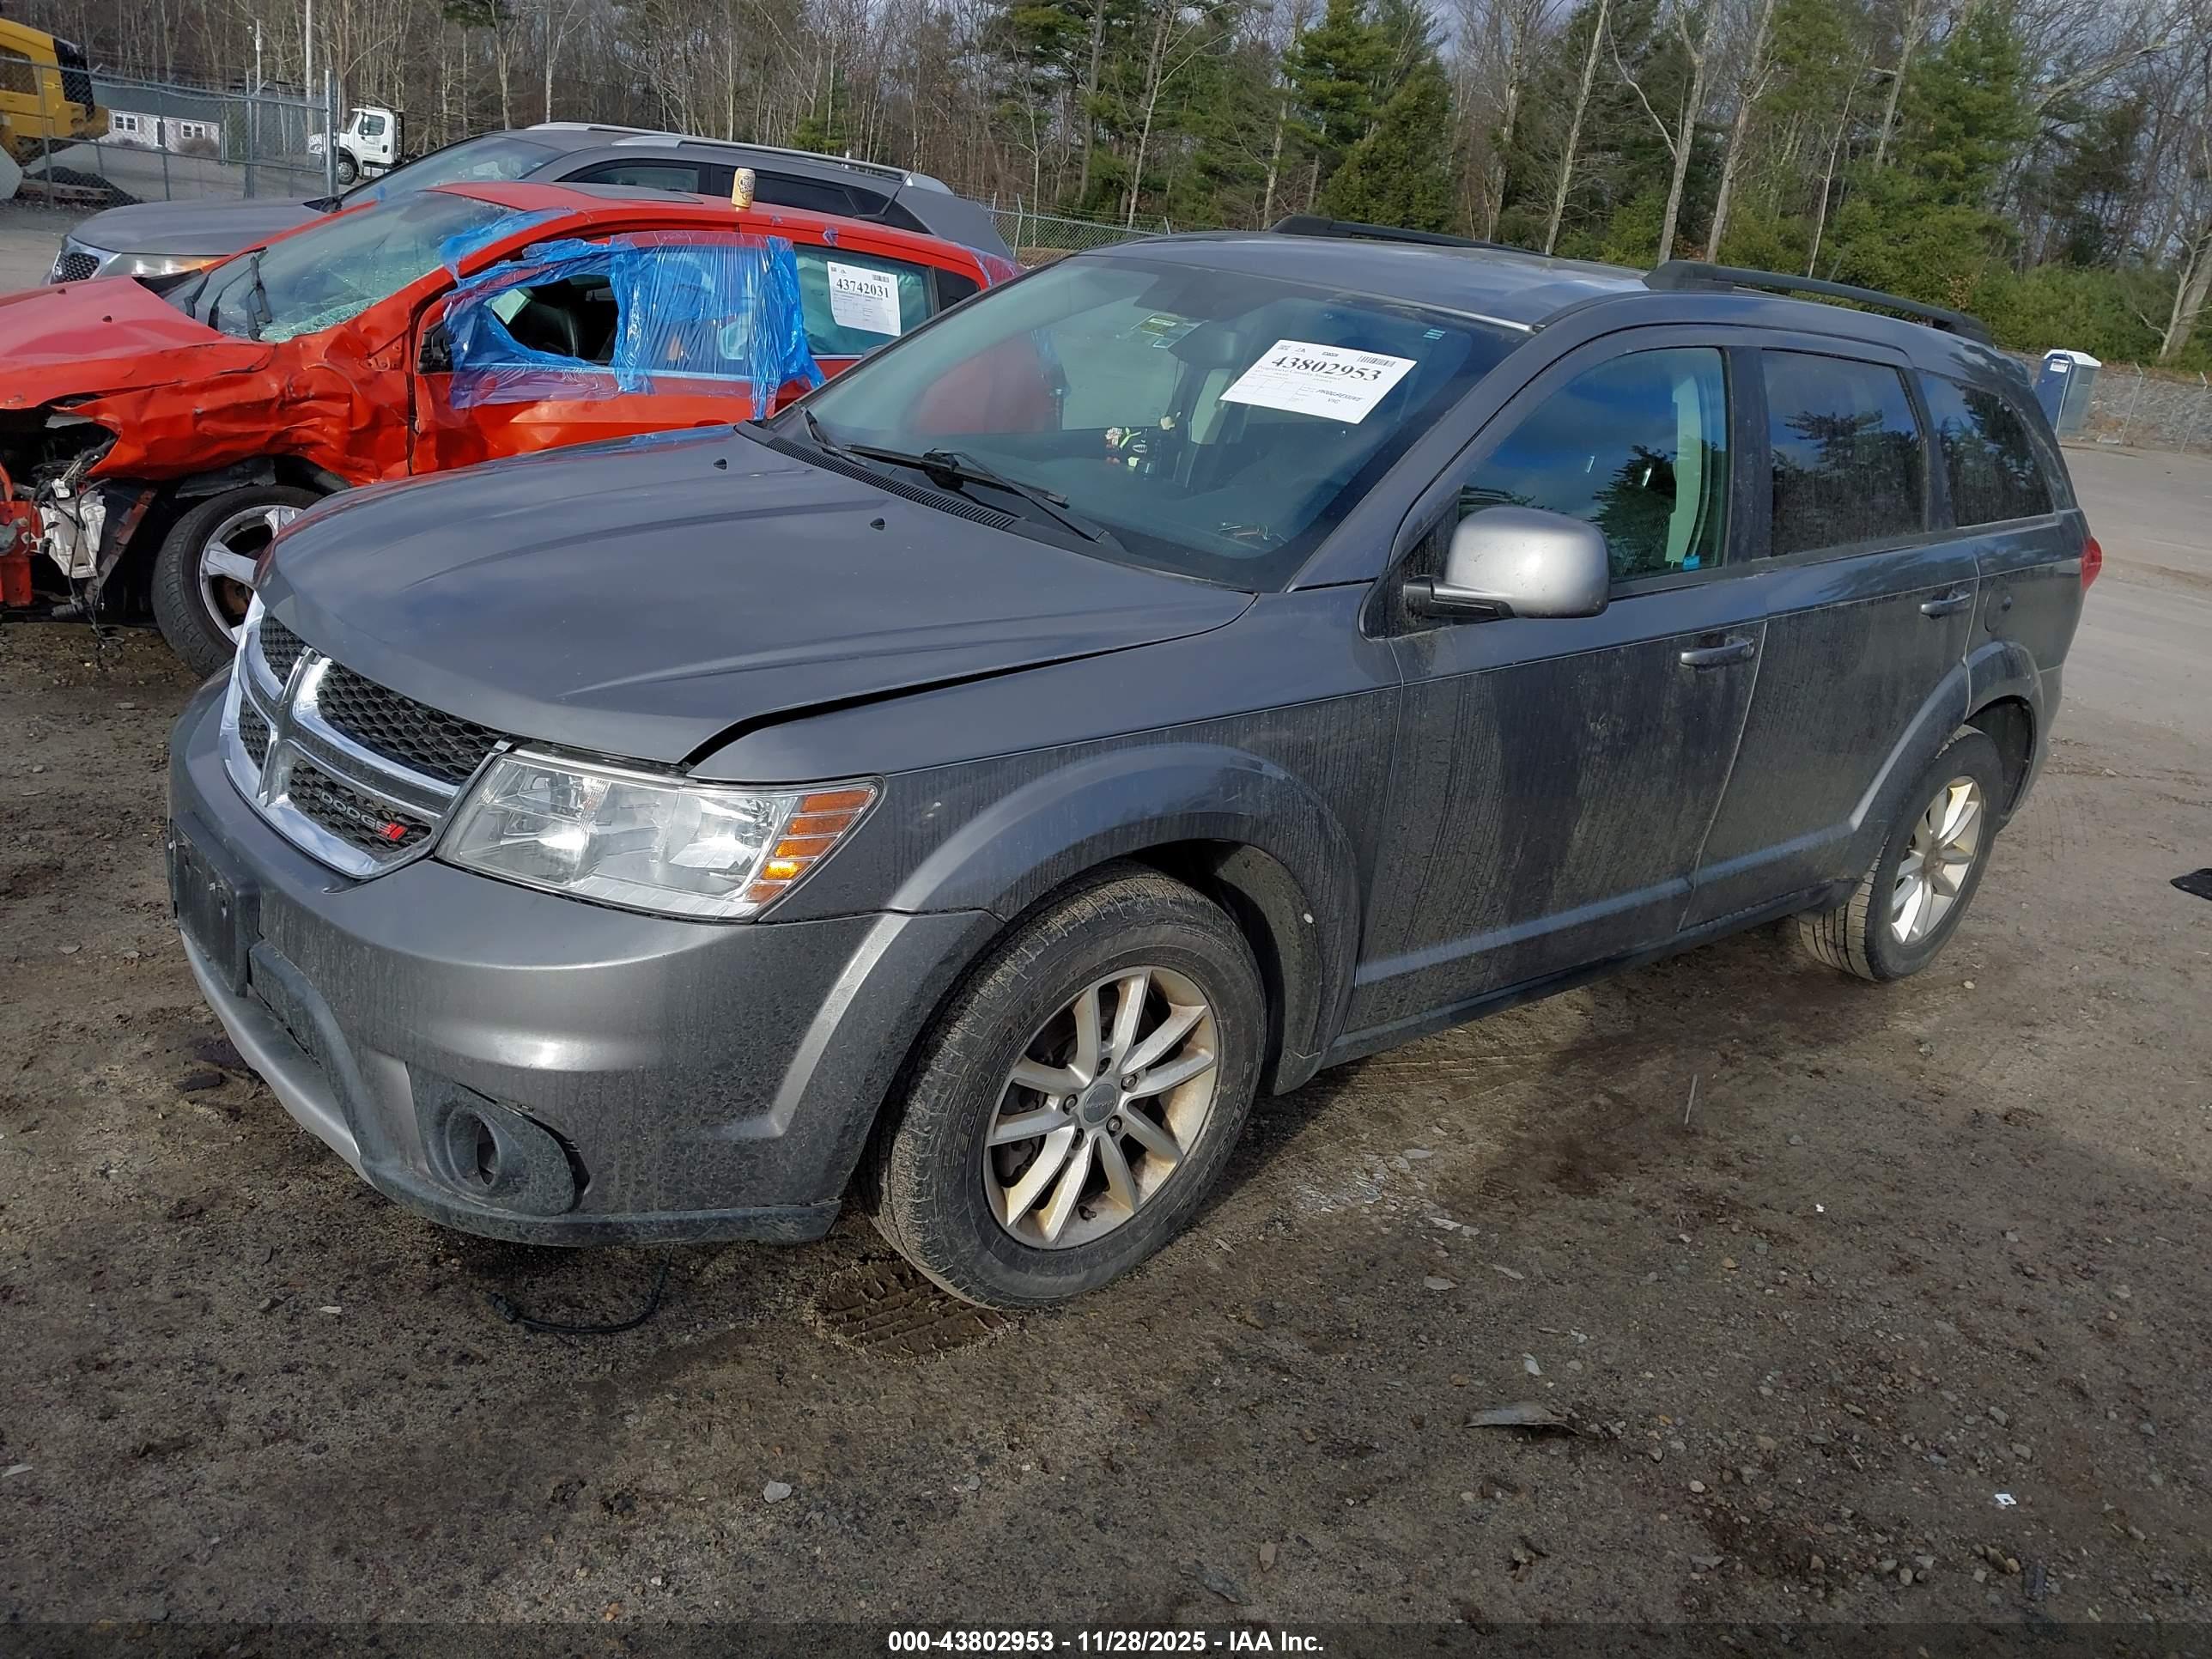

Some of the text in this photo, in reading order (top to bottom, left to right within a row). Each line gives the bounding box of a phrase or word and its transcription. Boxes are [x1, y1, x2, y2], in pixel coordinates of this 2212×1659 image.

[836, 277, 890, 298] 43742031
[1271, 356, 1382, 381] 43802953
[321, 791, 392, 835] DODGE
